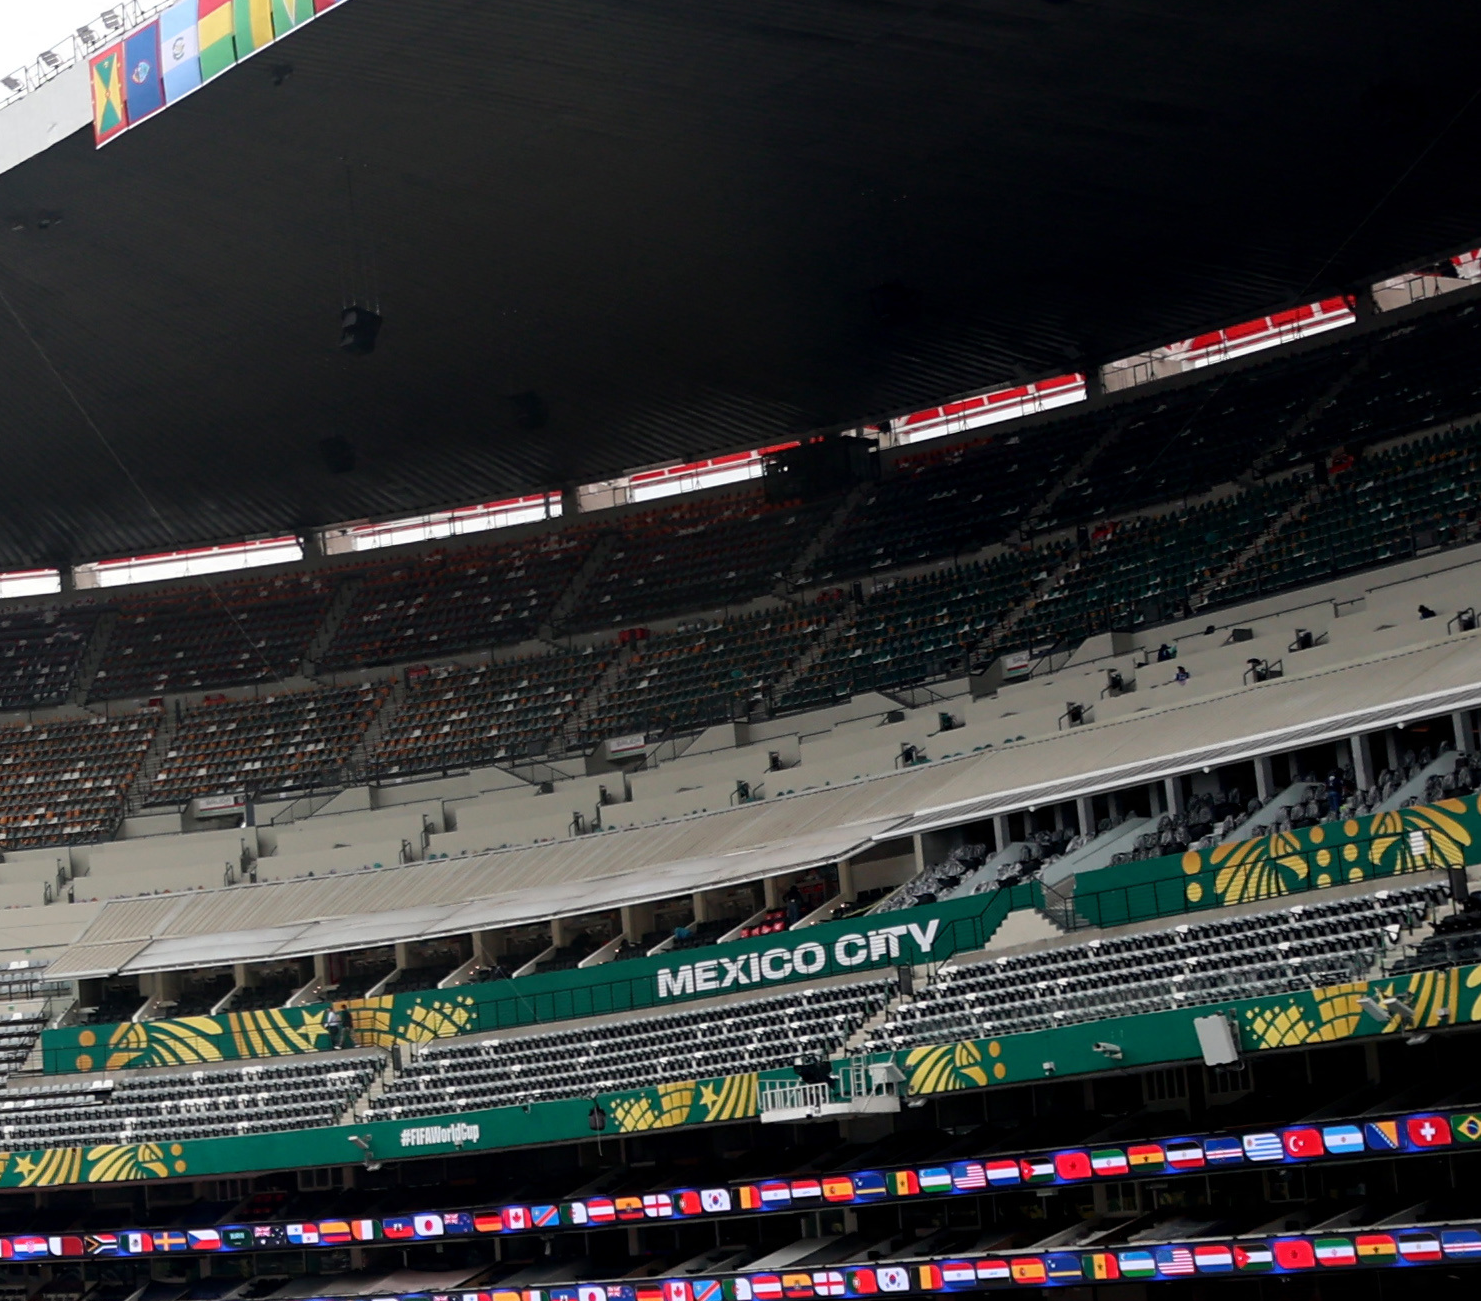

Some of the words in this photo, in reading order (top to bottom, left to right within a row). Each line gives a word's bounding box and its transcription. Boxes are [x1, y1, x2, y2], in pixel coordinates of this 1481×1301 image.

[656, 941, 826, 999] MEXICO
[835, 919, 941, 967] CITY
[400, 1123, 480, 1146] #FIFAWorldCup
